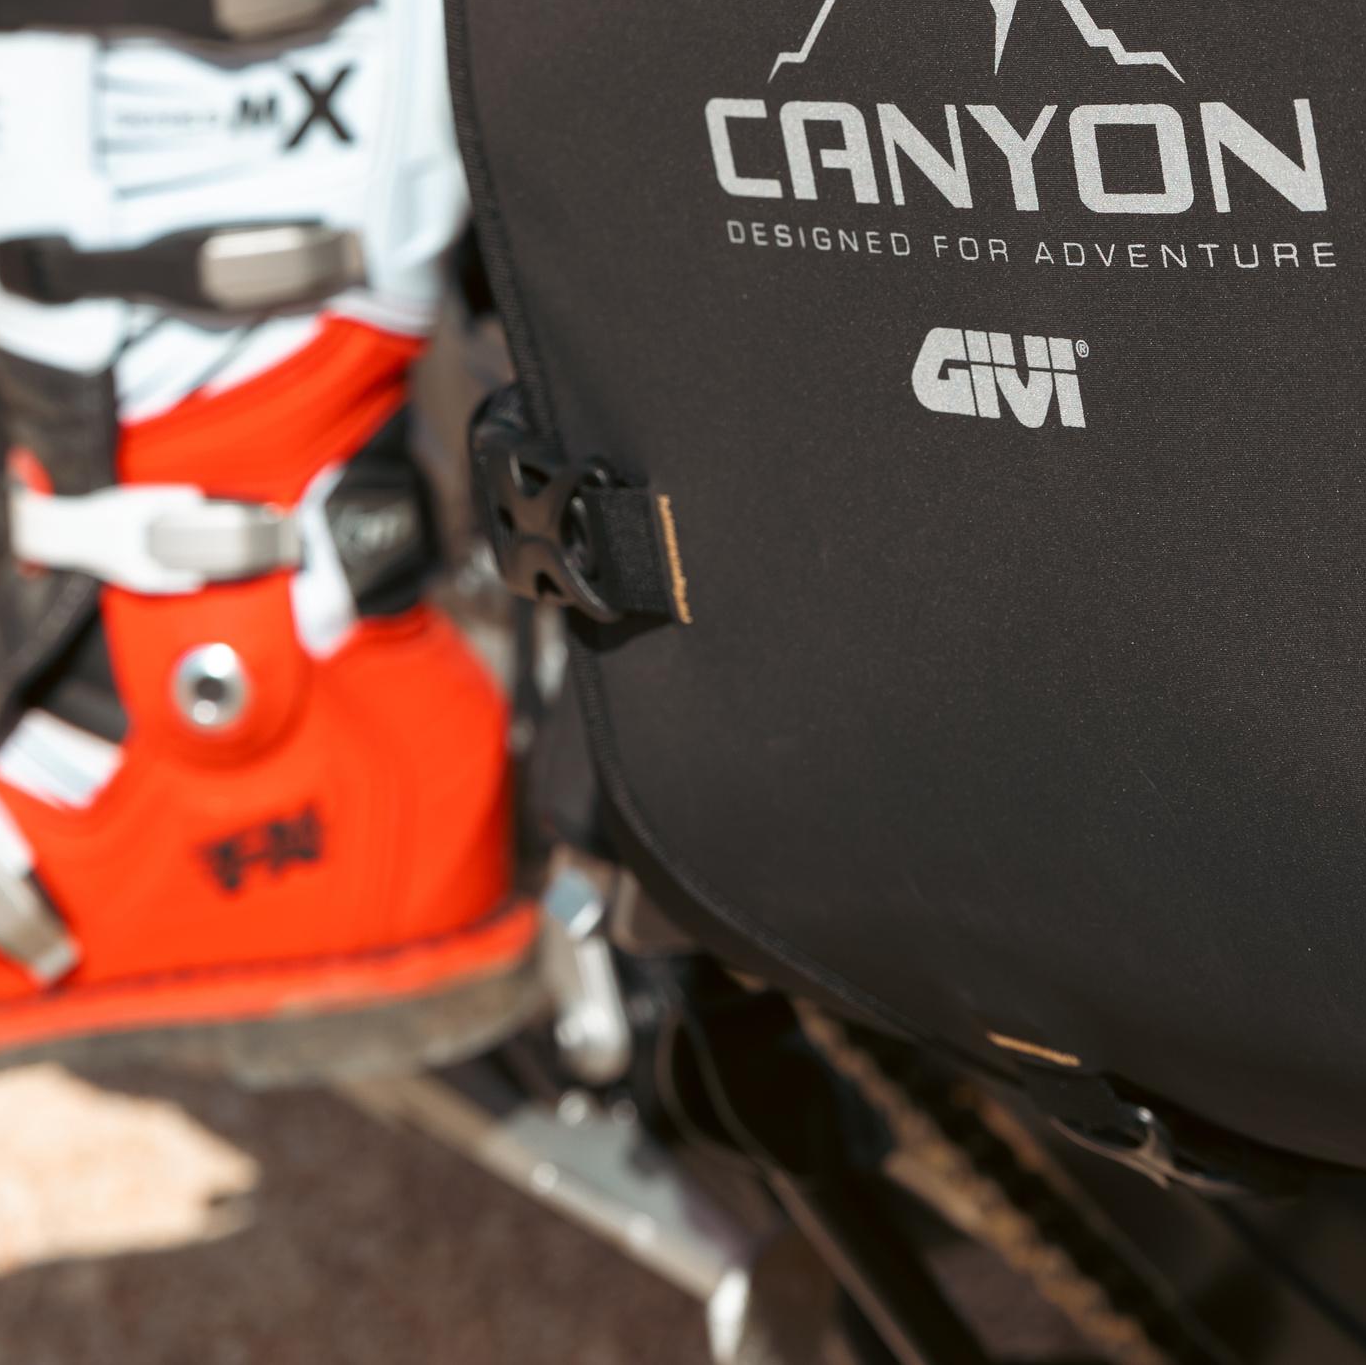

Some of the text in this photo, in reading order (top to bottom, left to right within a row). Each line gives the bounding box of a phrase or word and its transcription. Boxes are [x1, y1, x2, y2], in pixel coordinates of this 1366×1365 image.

[704, 97, 1327, 214] CANYON
[726, 219, 1337, 269] DESIGNED FOR ADVENTURE
